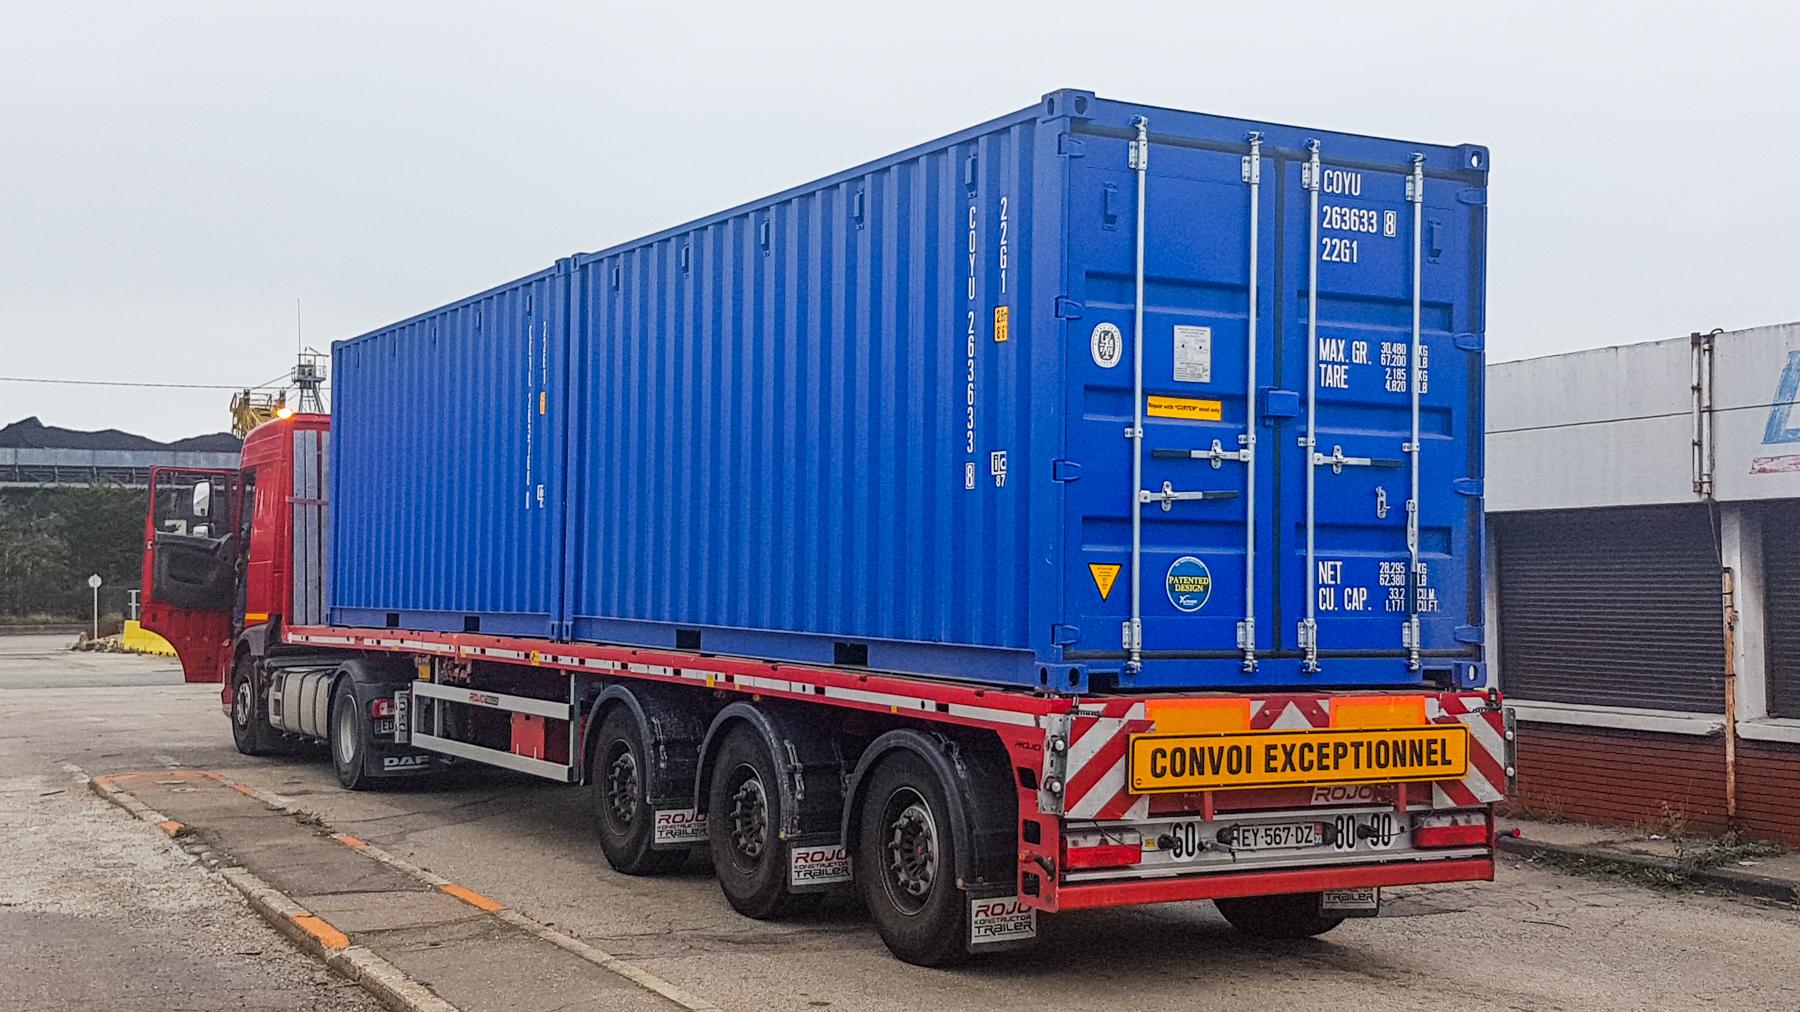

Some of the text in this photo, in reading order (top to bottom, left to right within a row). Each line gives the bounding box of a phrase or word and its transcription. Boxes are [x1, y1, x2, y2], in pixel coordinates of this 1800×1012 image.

[1323, 169, 1361, 196] COYU
[1322, 205, 1394, 235] 263633 8
[968, 206, 977, 300] COYU
[1000, 196, 1008, 294] 22G1
[1321, 237, 1358, 264] 22G1
[1319, 337, 1350, 364] MAX.
[1352, 341, 1372, 365] GR.
[966, 311, 976, 453] 263633
[1319, 364, 1349, 389] TARE
[995, 475, 1006, 487] 87
[1169, 576, 1209, 585] PATENTED
[1319, 561, 1342, 585] NET
[1417, 563, 1427, 574] KG
[1417, 574, 1427, 587] LB
[1175, 584, 1204, 592] DESIGN
[1319, 587, 1338, 611] CU.
[1344, 588, 1372, 611] CAP.
[1014, 742, 1042, 751] ROJO
[1150, 737, 1453, 779] CONVOI EXCEPTIONNEL
[383, 755, 430, 766] DAF
[1314, 785, 1374, 802] ROJO
[657, 810, 708, 824] ROJO
[1334, 815, 1355, 849] 80
[795, 848, 848, 863] ROJO
[975, 901, 1032, 917] ROJO
